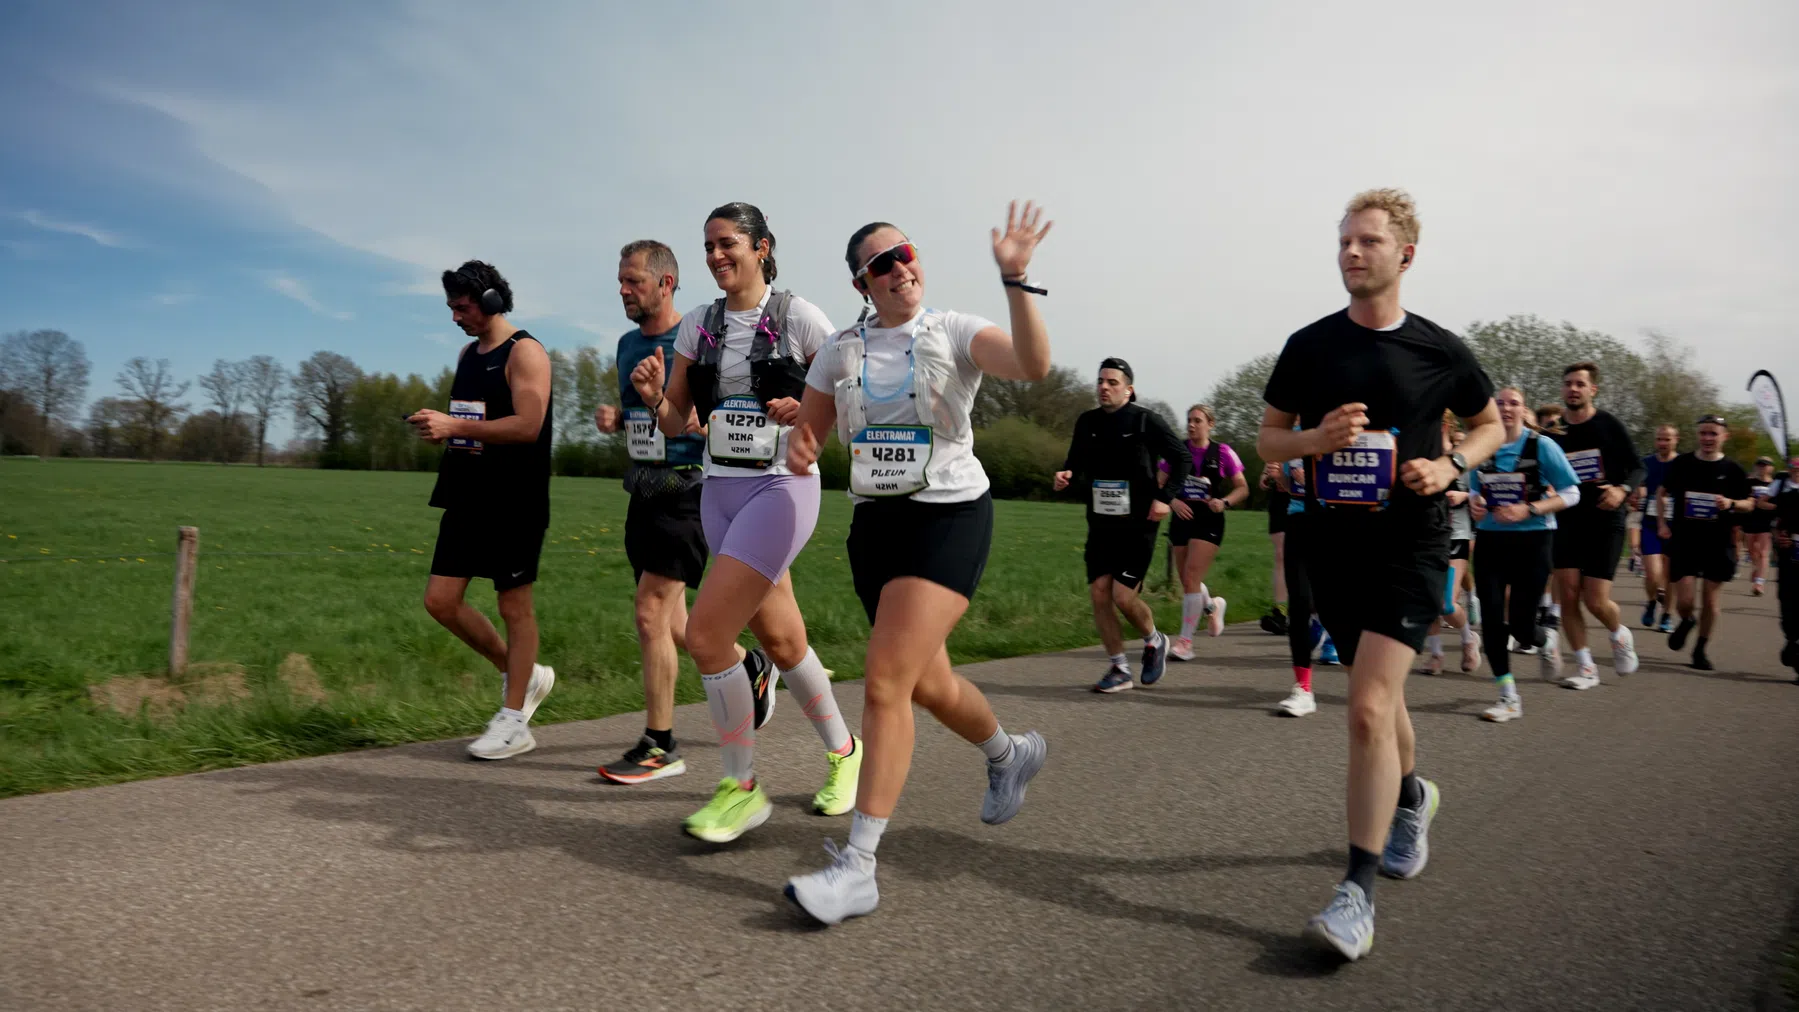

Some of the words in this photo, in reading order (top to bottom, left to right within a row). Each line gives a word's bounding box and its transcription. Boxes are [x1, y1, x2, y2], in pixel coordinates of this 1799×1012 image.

[723, 400, 762, 410] ELEKTRAMA
[726, 413, 766, 428] 4270
[728, 432, 754, 442] NINA
[866, 430, 916, 441] ELEKTRAMAT
[731, 446, 750, 454] 42KM
[872, 447, 916, 462] 4281
[1332, 451, 1380, 468] 6163
[871, 469, 906, 478] PLEUN
[1327, 473, 1377, 484] DUNCAN
[875, 482, 898, 491] 42KM
